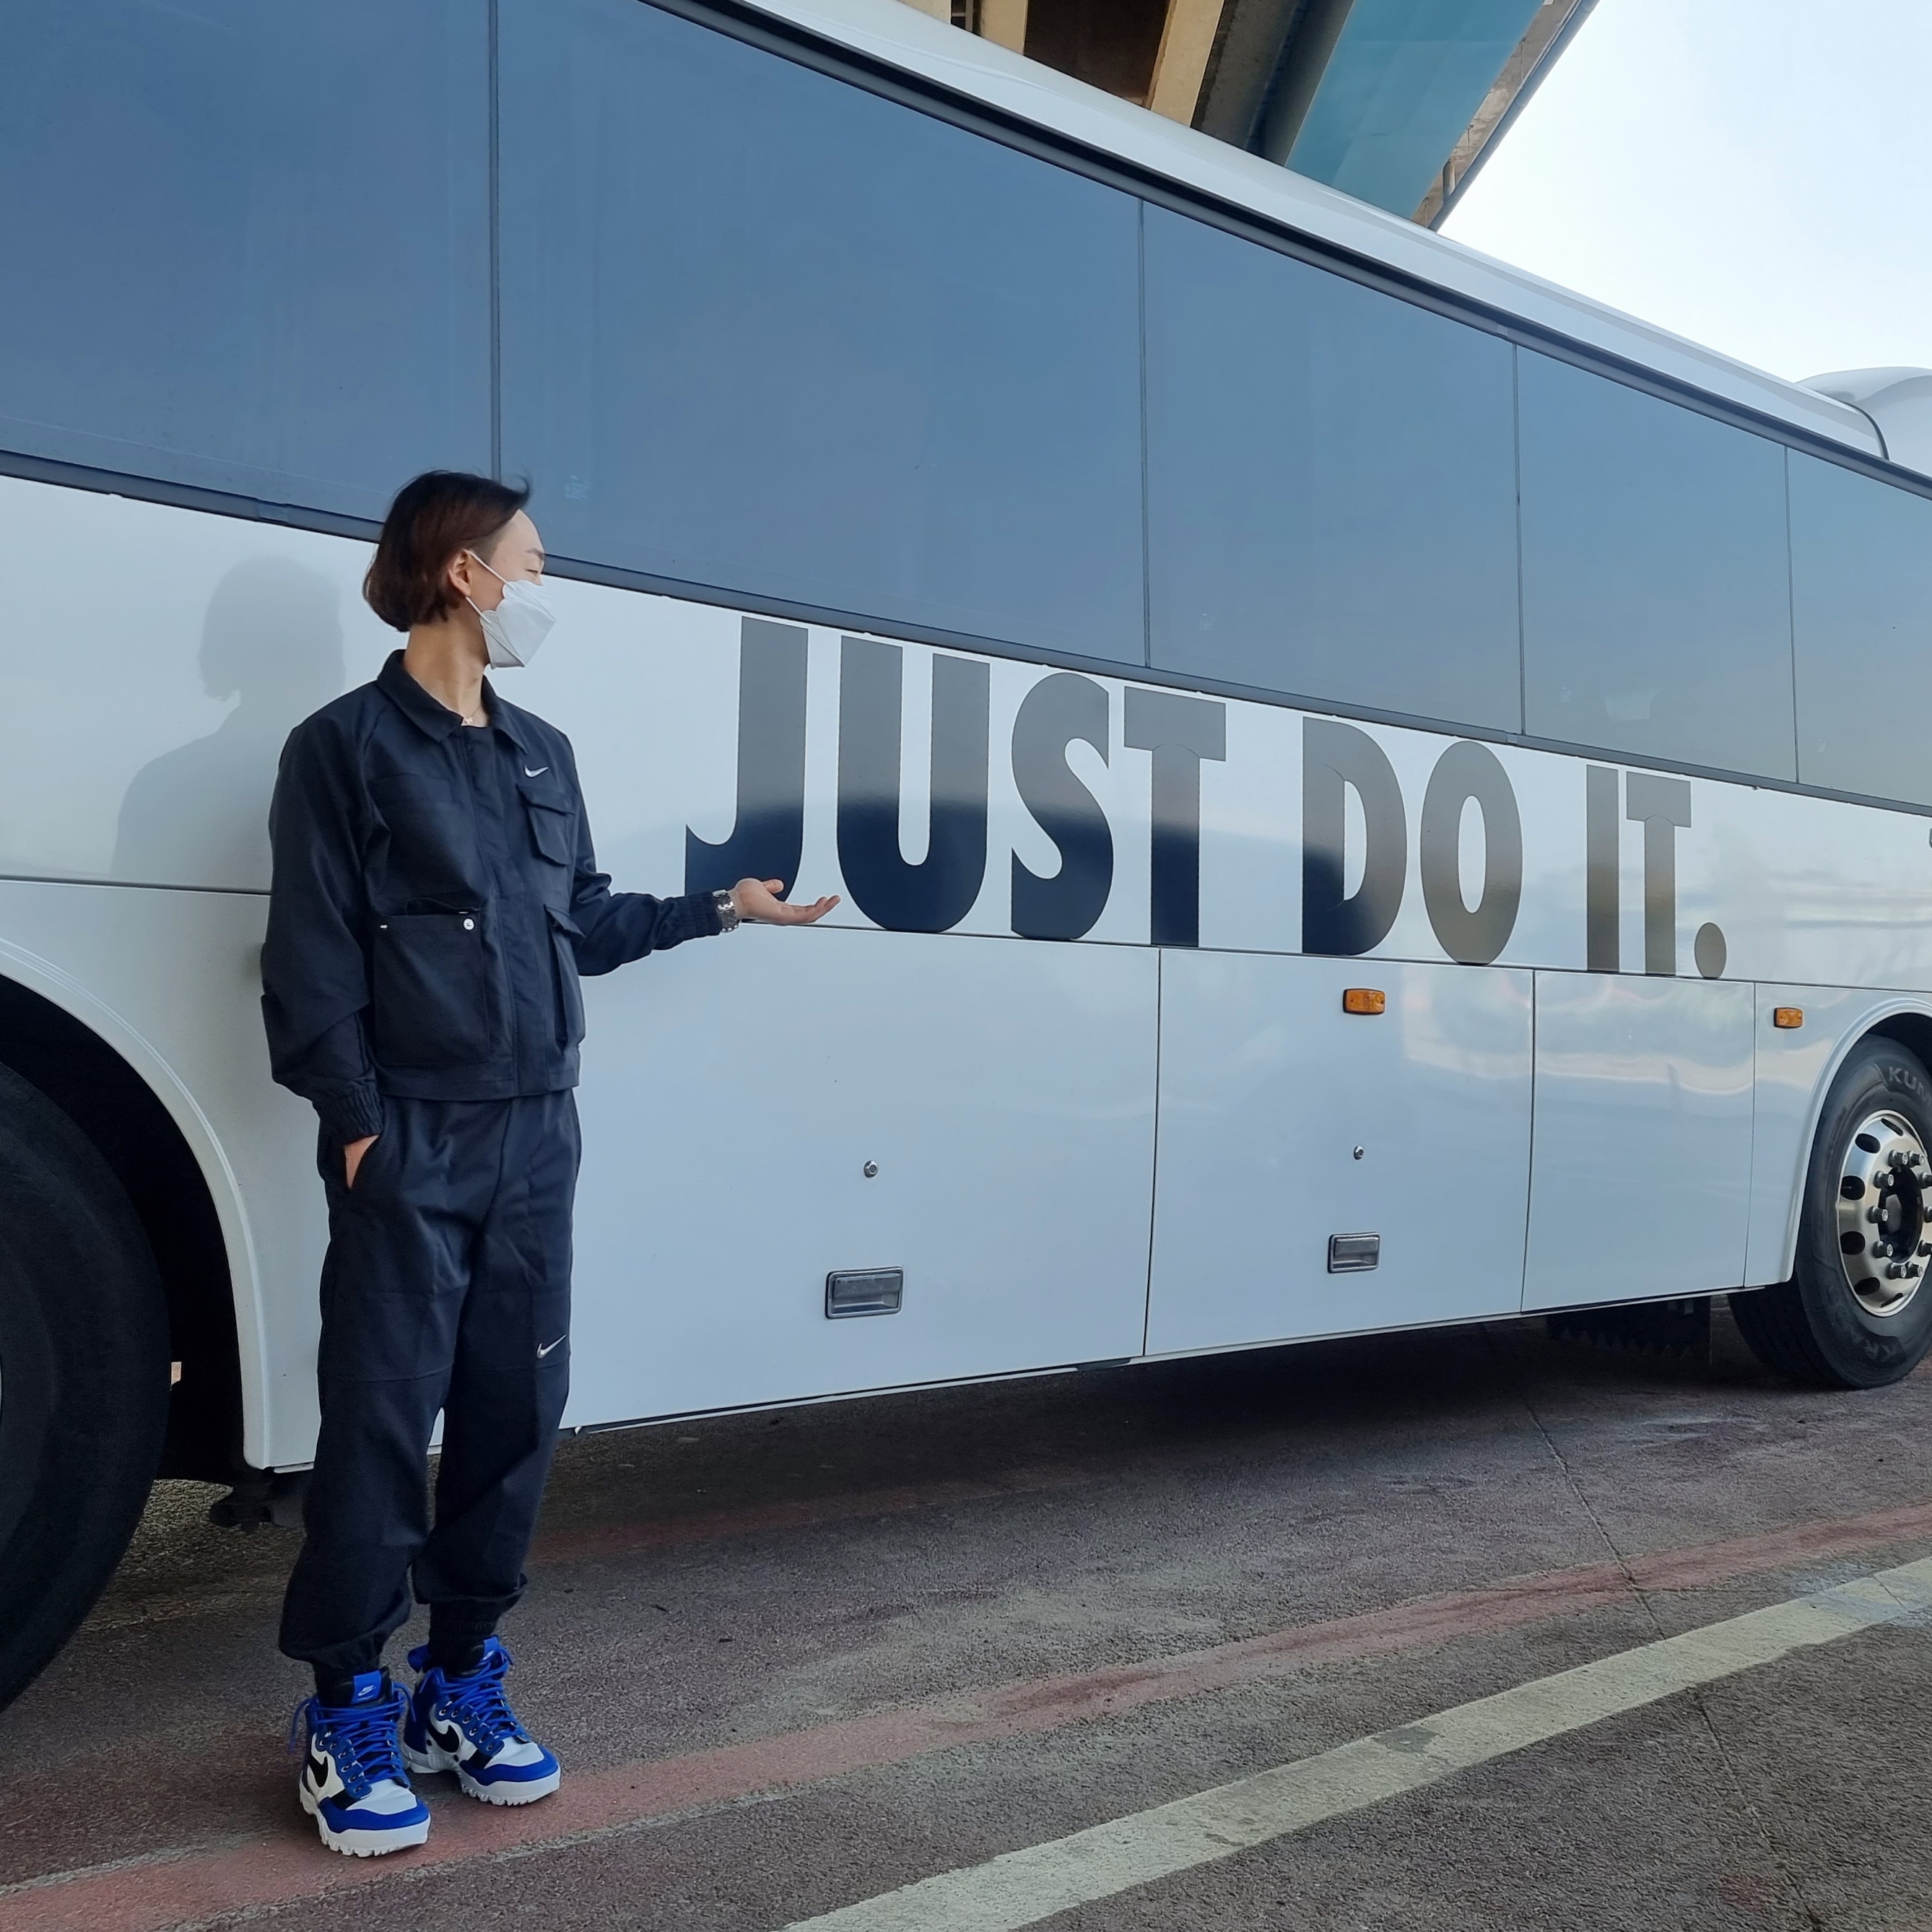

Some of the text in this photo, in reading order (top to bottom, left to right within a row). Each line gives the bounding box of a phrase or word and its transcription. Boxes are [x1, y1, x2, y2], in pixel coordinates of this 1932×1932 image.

[685, 616, 1727, 980] JUST DO IT.
